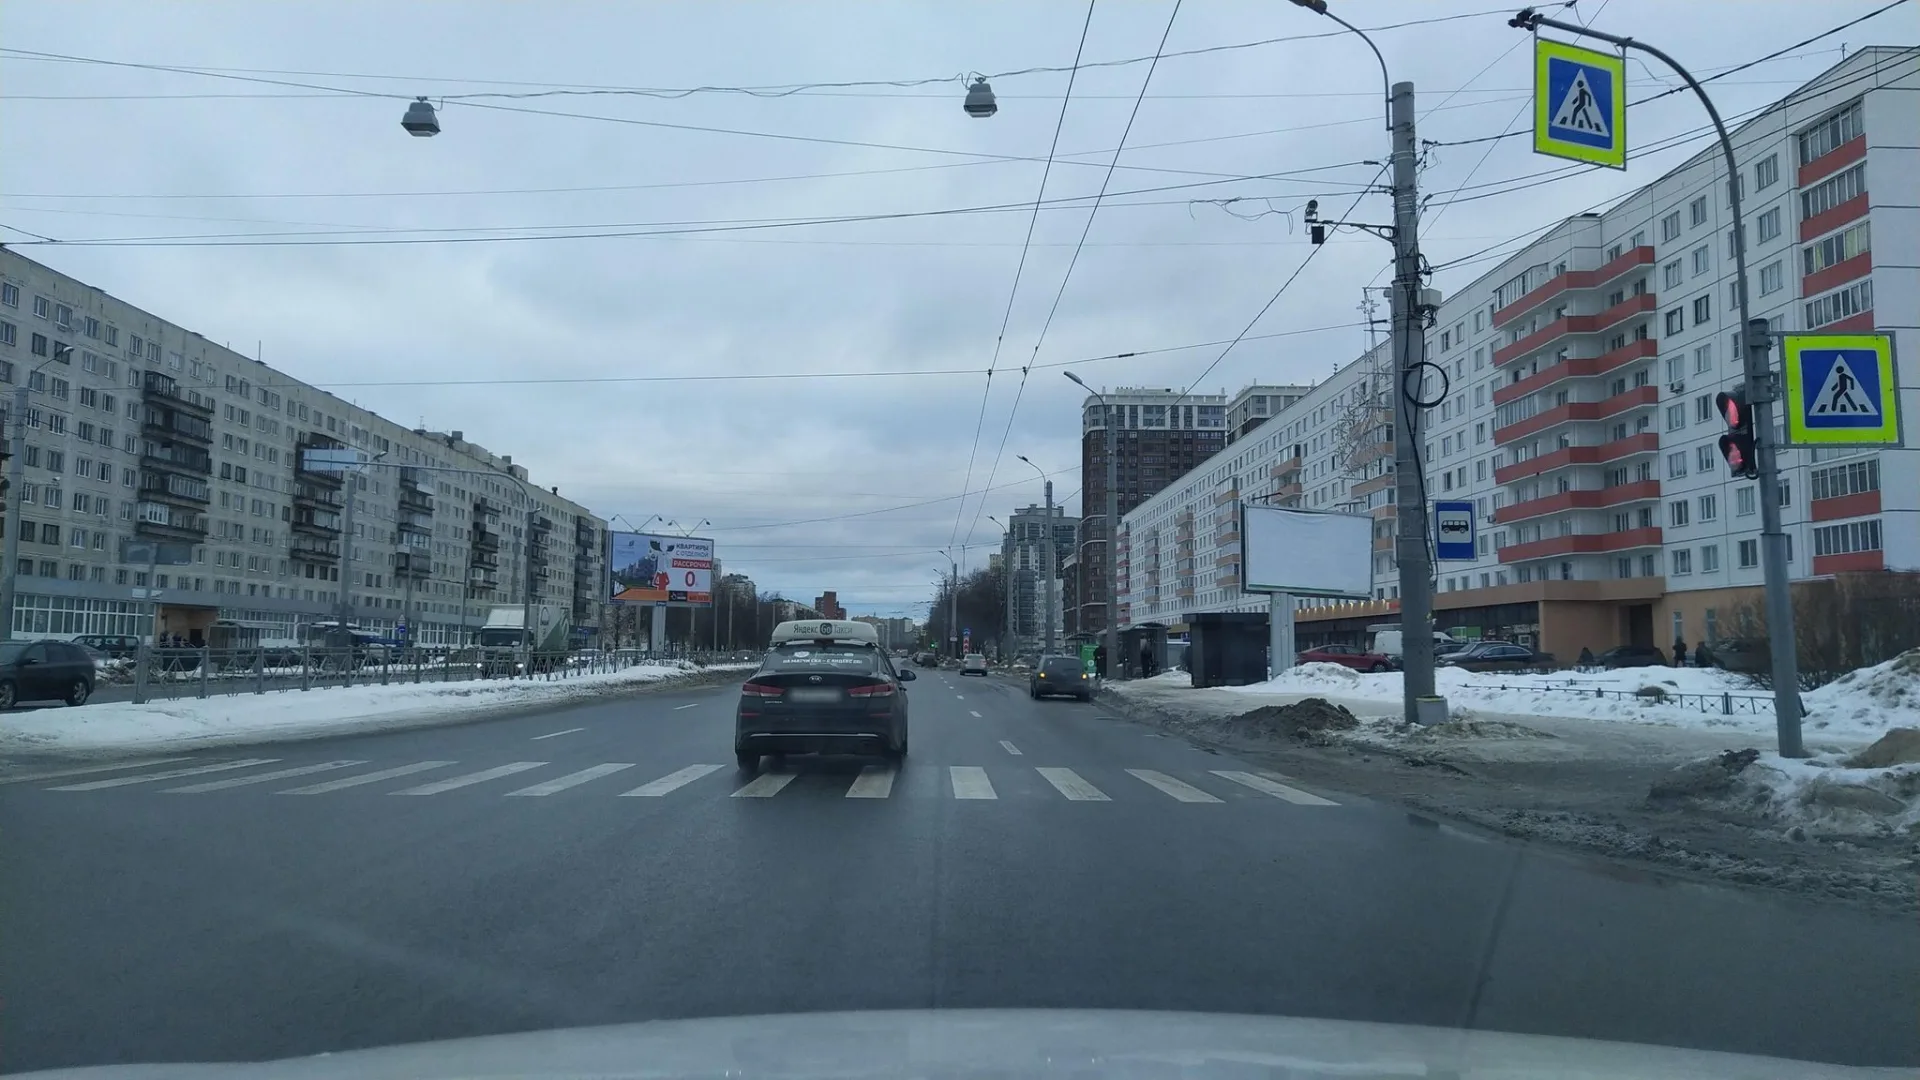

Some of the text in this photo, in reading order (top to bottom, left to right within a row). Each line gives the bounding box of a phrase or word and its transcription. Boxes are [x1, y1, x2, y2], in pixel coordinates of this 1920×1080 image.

[673, 560, 710, 568] РАССРОЧКА
[685, 571, 696, 587] 0
[793, 624, 818, 634] Яндекс
[834, 624, 852, 634] Такси
